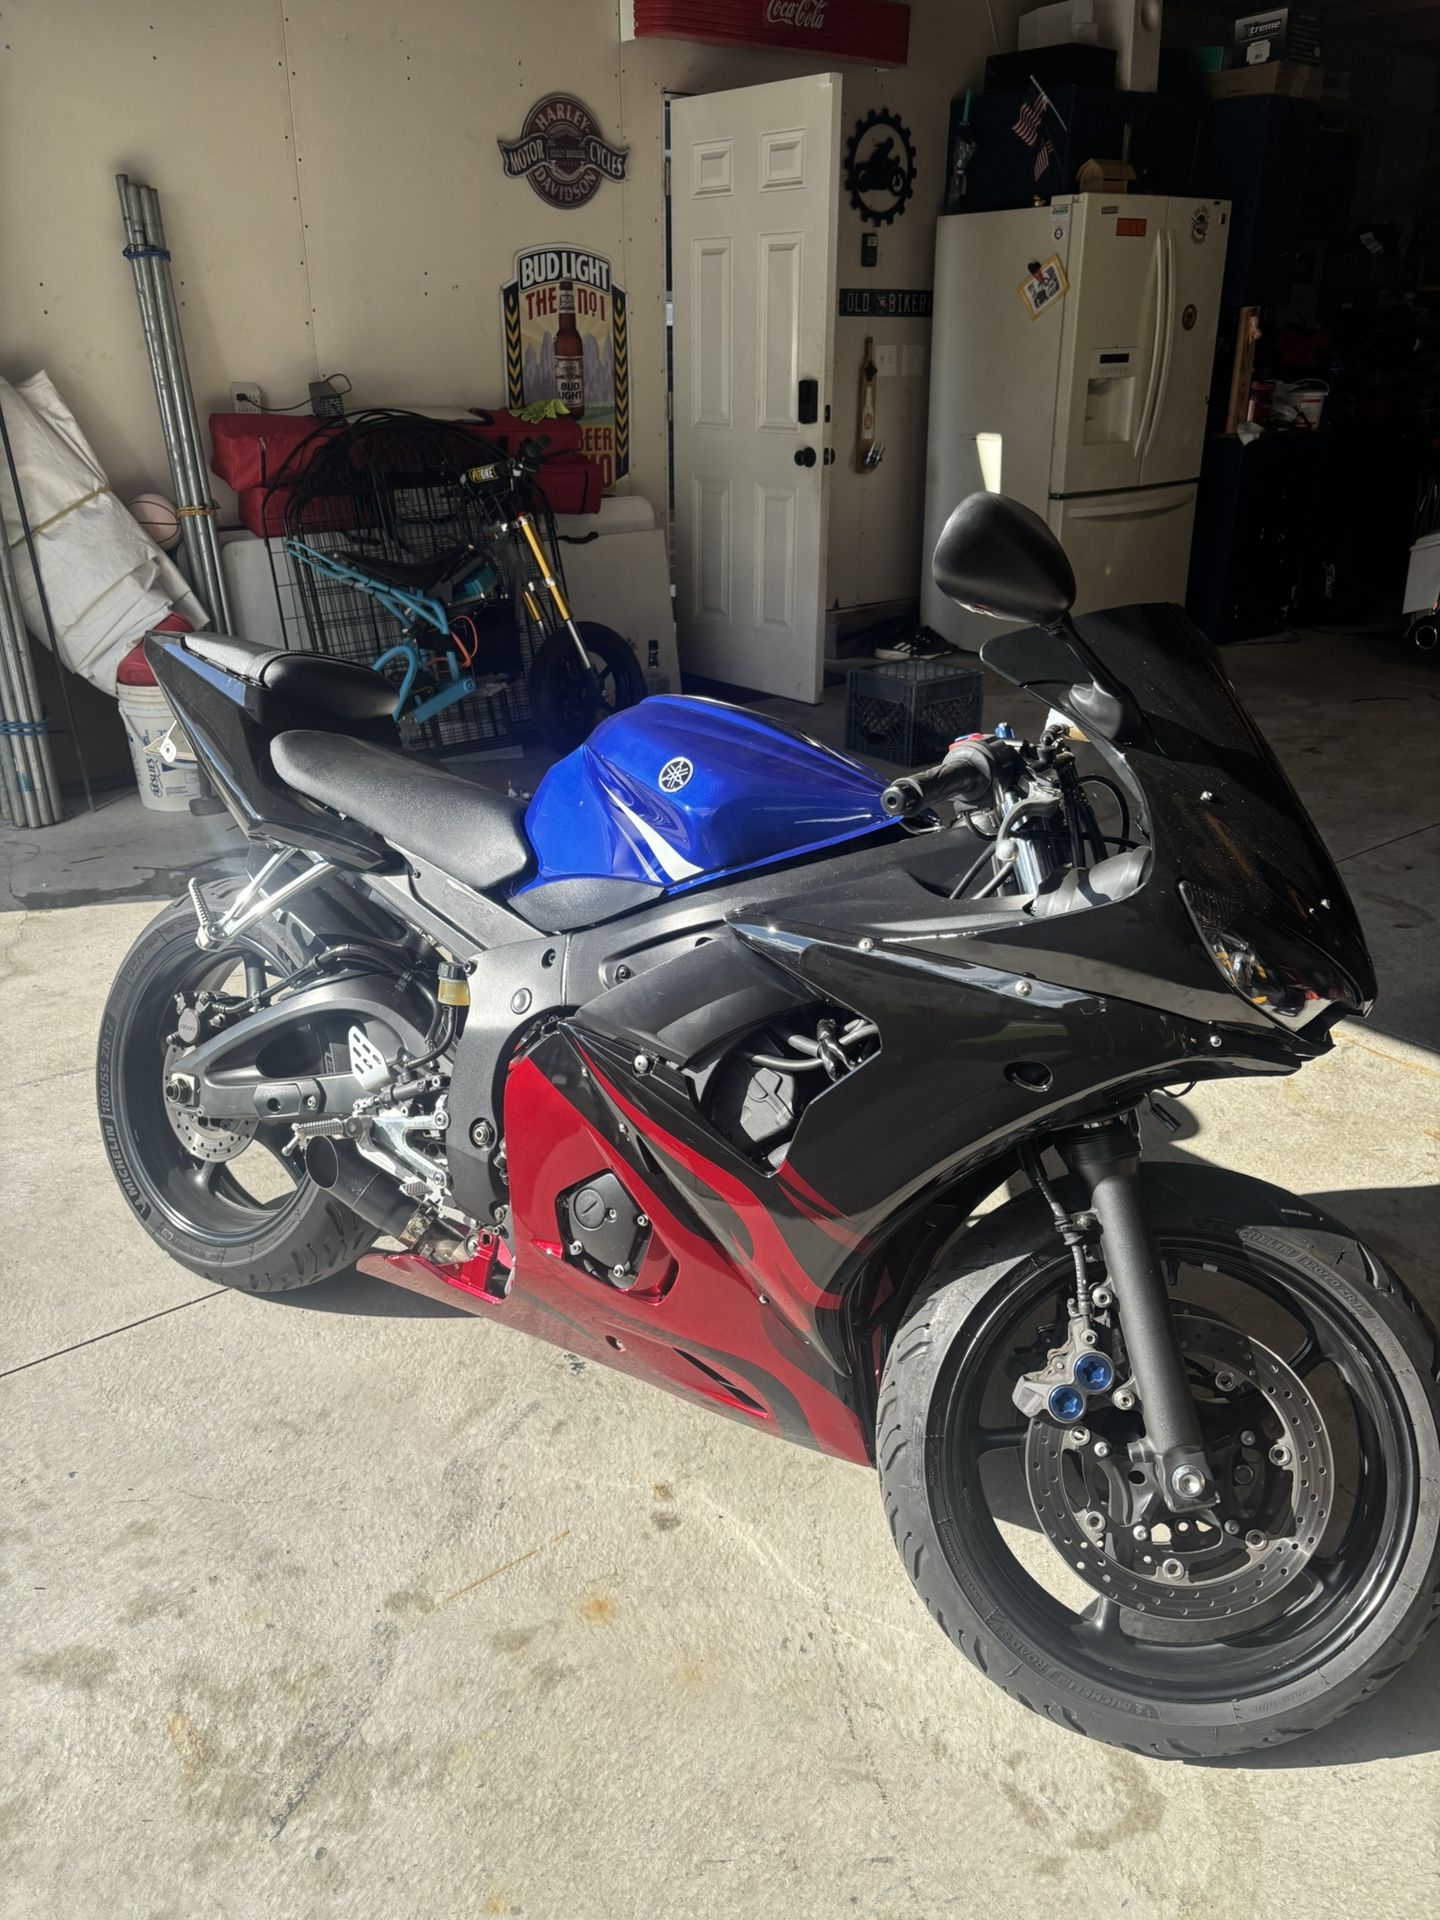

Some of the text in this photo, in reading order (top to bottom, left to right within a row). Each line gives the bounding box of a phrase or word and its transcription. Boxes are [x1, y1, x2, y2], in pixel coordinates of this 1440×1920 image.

[535, 103, 591, 133] HARLEY-
[510, 139, 623, 176] MOTOR CYCLES
[534, 167, 597, 201] DAVIDSON
[520, 252, 609, 294] BUD LIGHT
[525, 287, 557, 321] THE
[847, 292, 927, 313] OLD BIKER
[558, 390, 583, 400] LIGHT
[560, 382, 580, 392] BUD
[576, 427, 613, 451] BEER
[101, 1041, 112, 1058] ZR
[100, 1064, 112, 1114] 180/55
[105, 1125, 138, 1200] MICHELIN
